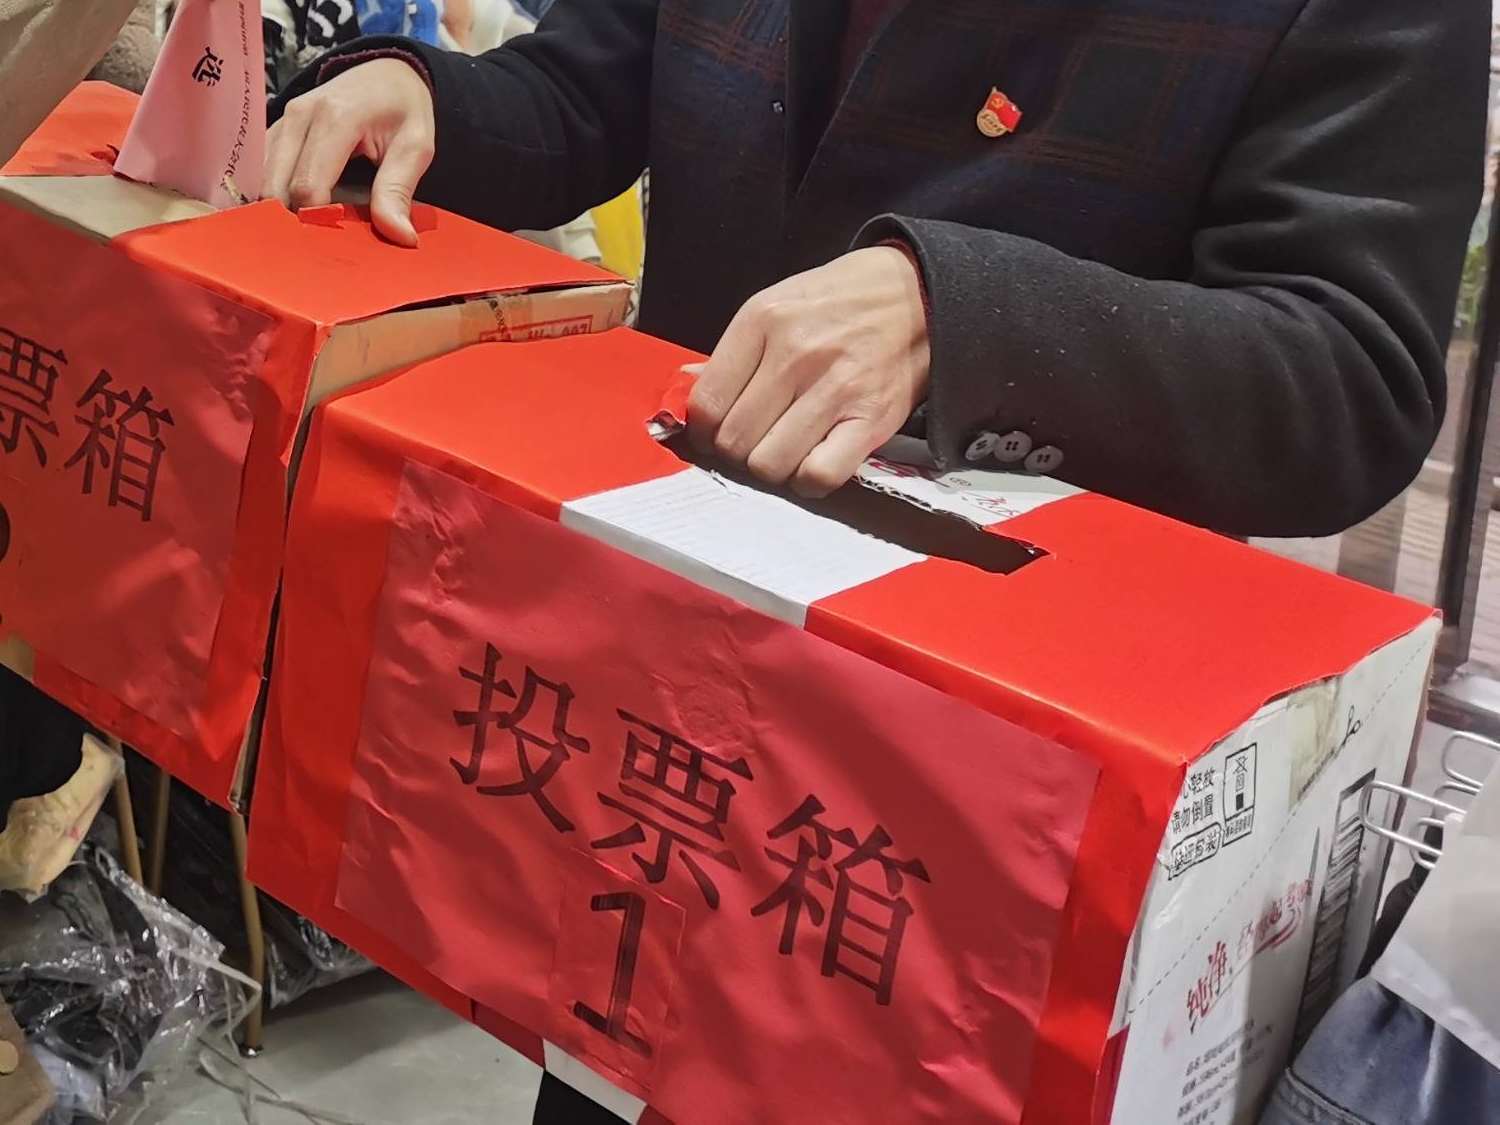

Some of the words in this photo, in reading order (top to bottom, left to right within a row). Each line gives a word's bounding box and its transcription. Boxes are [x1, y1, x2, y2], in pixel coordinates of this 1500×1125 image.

[192, 46, 224, 87] 选
[449, 641, 932, 1007] 投票箱
[573, 890, 653, 1061] 1
